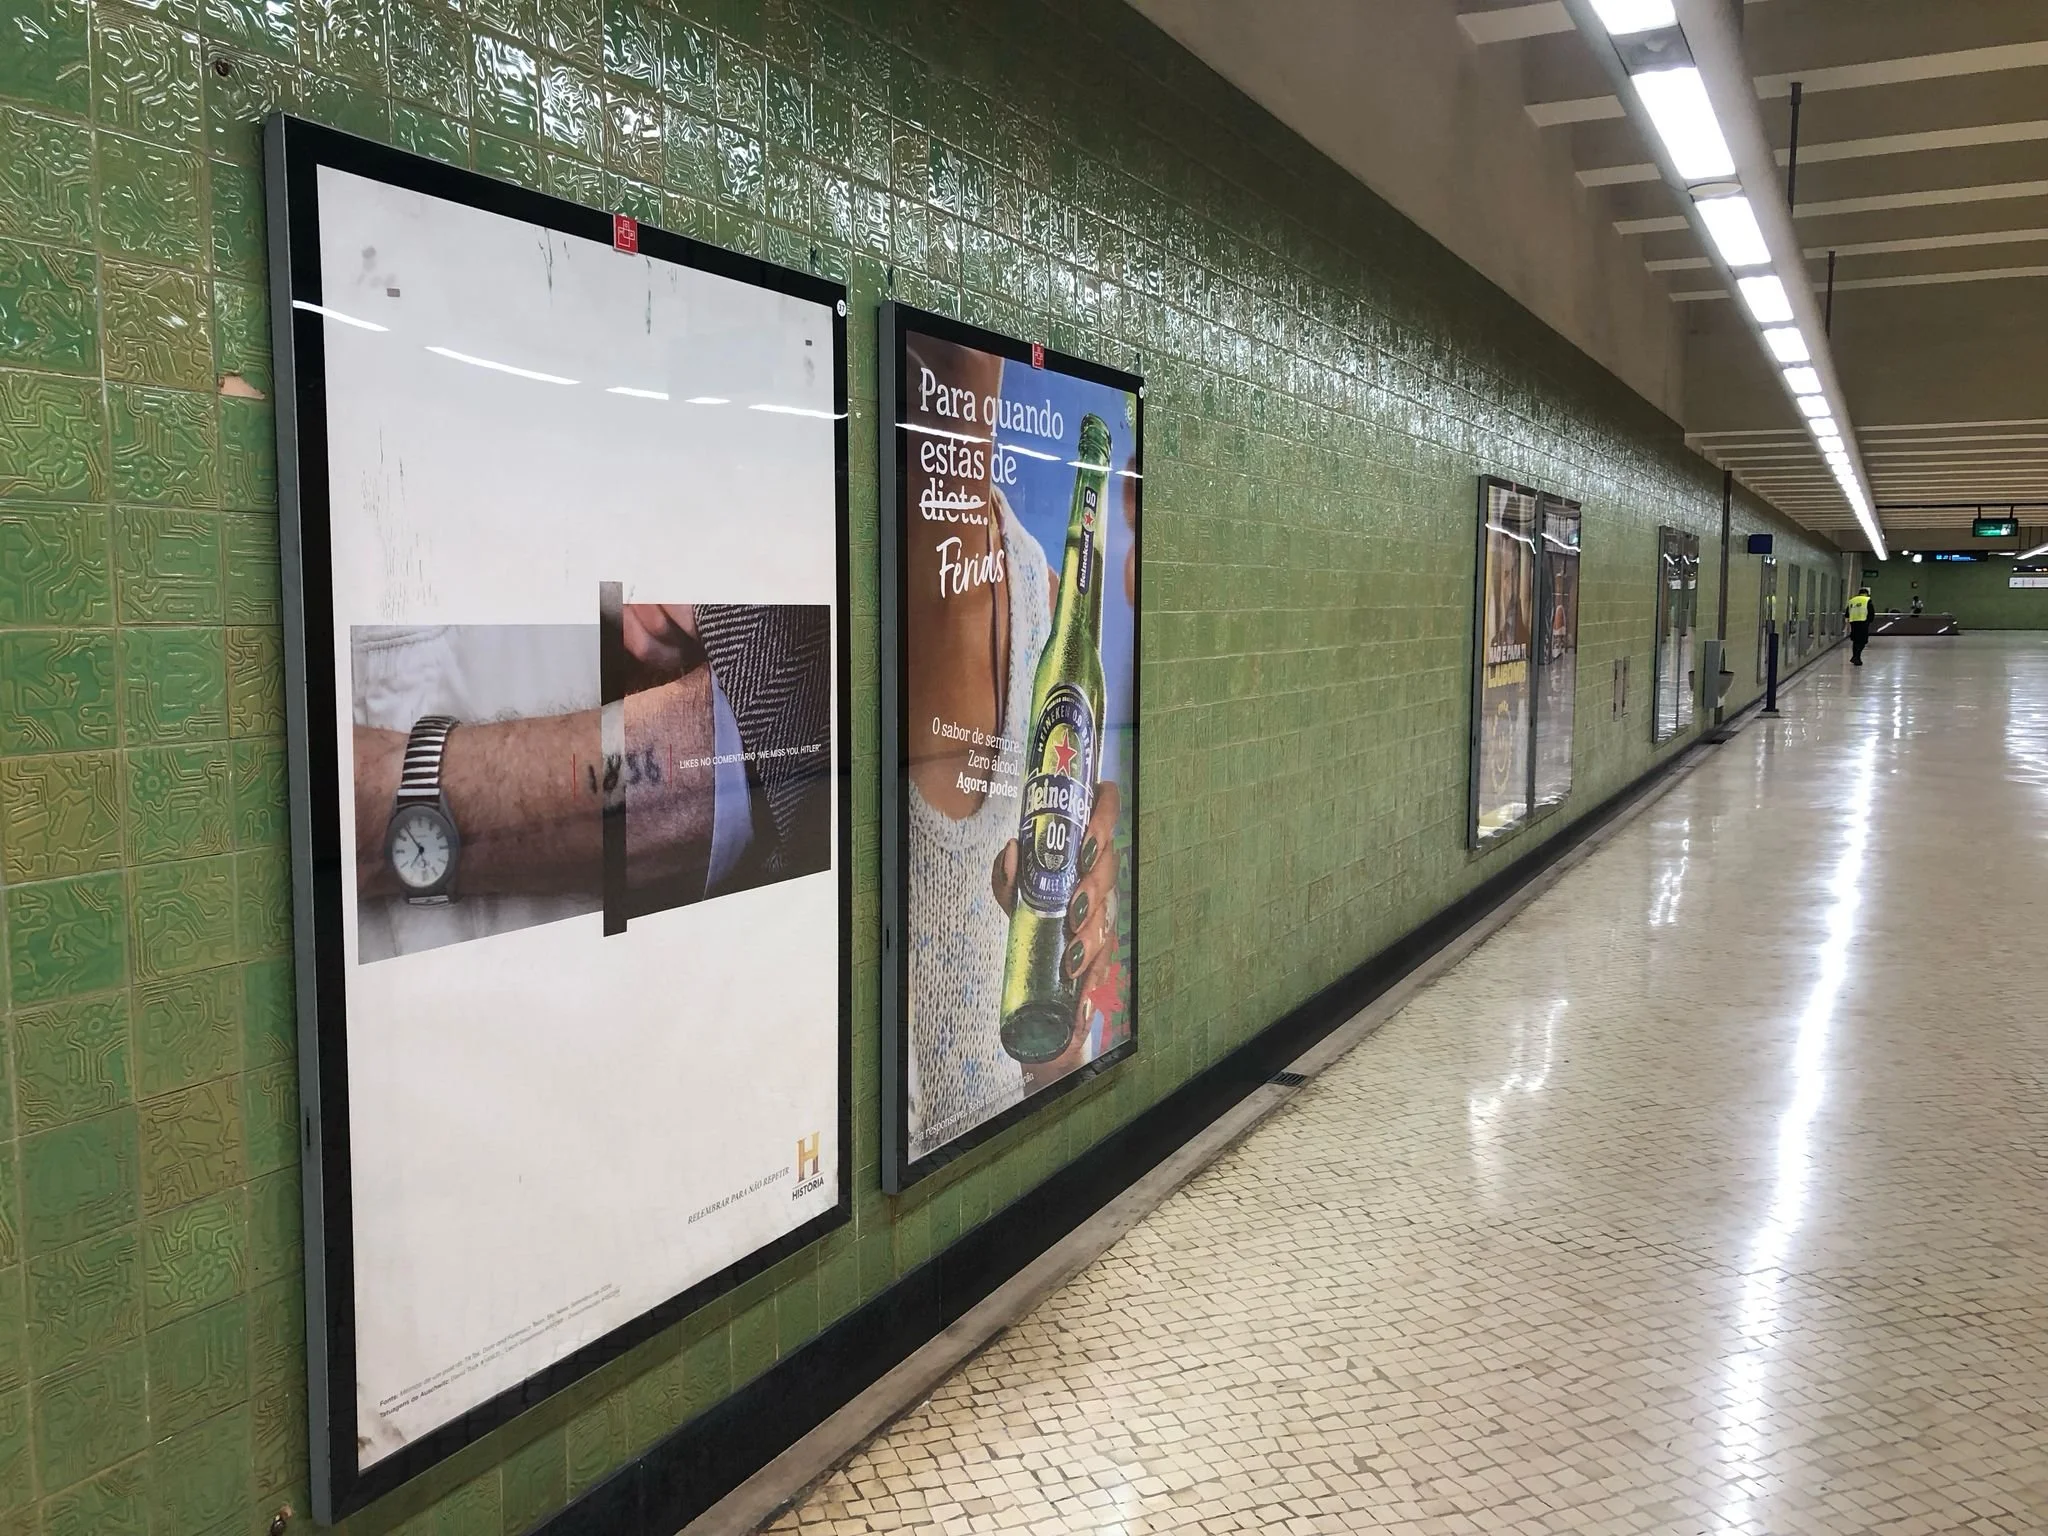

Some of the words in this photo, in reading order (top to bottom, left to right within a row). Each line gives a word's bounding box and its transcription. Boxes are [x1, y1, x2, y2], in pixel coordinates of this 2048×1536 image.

[920, 367, 977, 423] Para
[983, 395, 1064, 440] quando
[991, 443, 1017, 485] de
[936, 536, 1005, 599] Férias
[1079, 531, 1090, 588] Heineken
[932, 717, 941, 735] O
[941, 721, 971, 742] sabor
[971, 727, 984, 745] de
[985, 734, 1022, 755] sempre.
[680, 758, 699, 769] LIKES
[700, 756, 711, 766] NO
[713, 751, 756, 765] COMENTÁRIO
[771, 749, 786, 758] MISS
[968, 749, 990, 770] Zero
[991, 754, 1020, 776] álcool.
[956, 771, 988, 794] Agora
[988, 780, 1018, 798] podes
[1046, 821, 1067, 851] 0.0
[796, 1131, 820, 1183] H
[687, 1196, 731, 1225] RELEMBRAR
[731, 1187, 748, 1203] PARA
[748, 1178, 762, 1194] NÃO
[763, 1166, 790, 1187] REPETIR
[379, 1400, 410, 1419] Tatuagens
